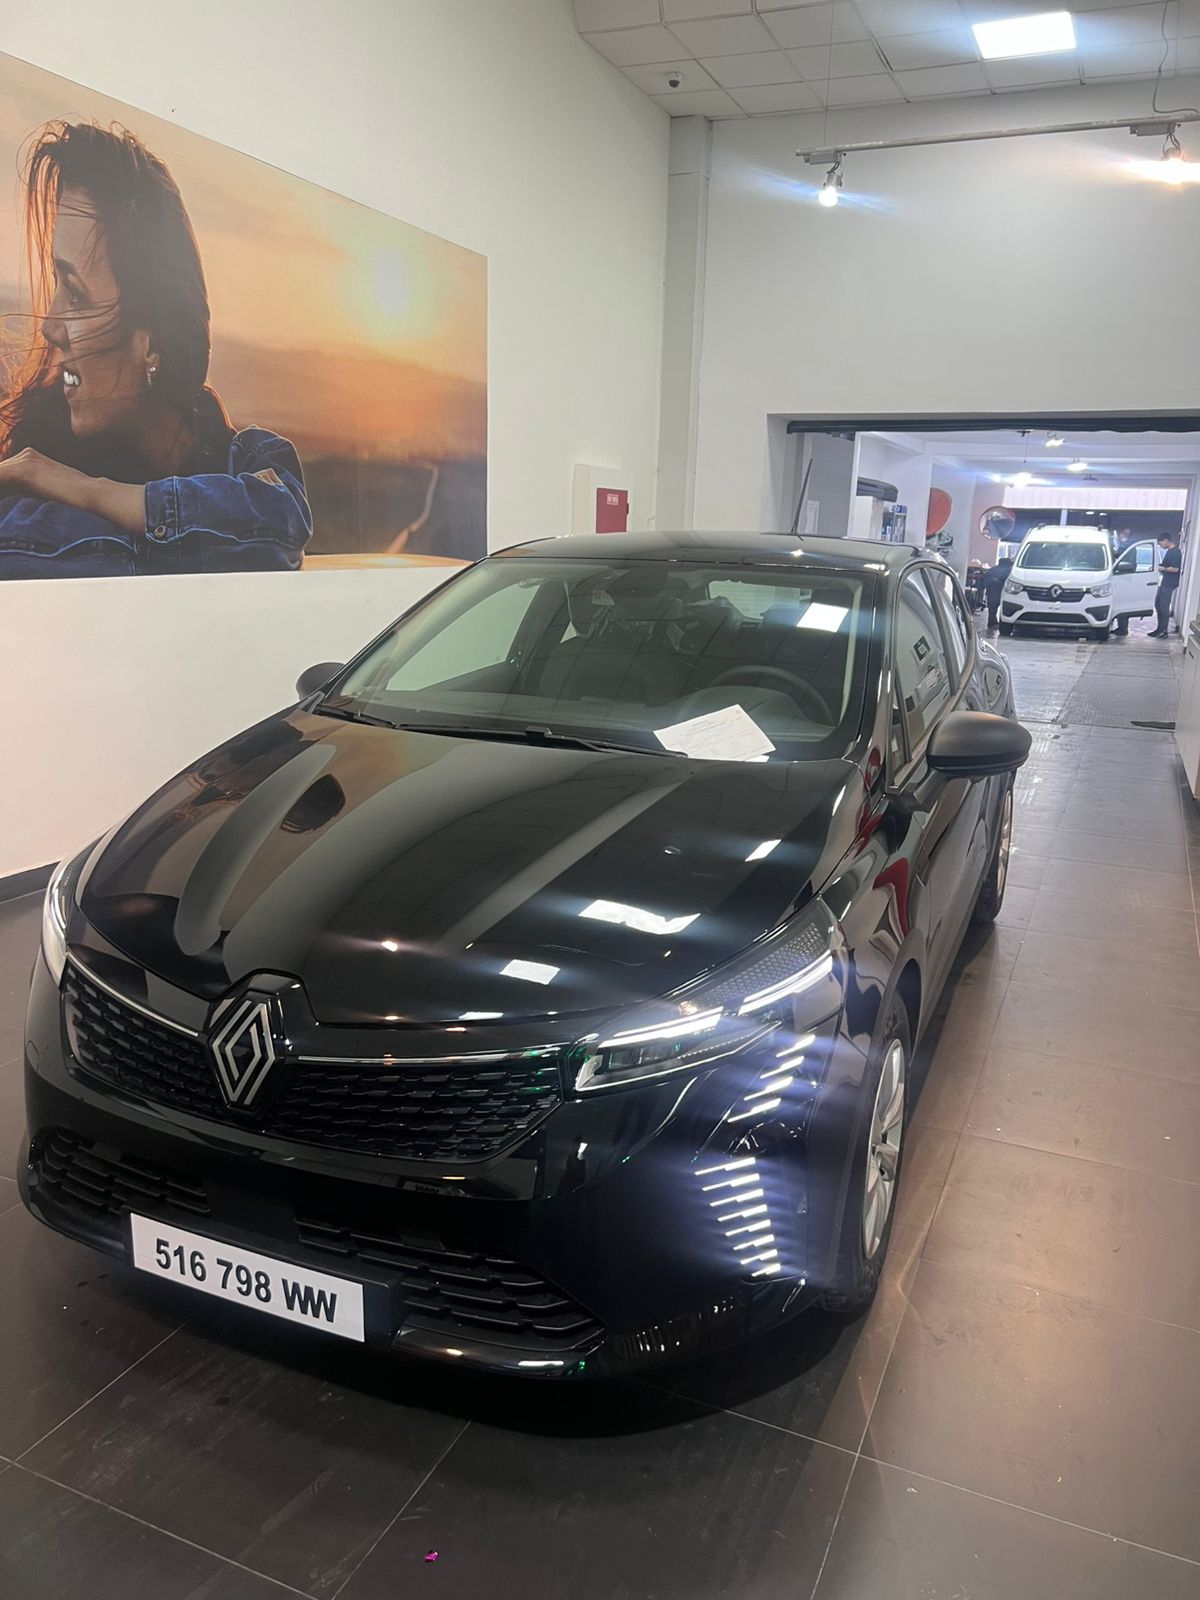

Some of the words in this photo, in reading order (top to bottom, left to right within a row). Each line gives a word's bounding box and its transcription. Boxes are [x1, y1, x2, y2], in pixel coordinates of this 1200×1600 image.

[155, 1238, 207, 1282] 516
[216, 1258, 272, 1303] 798
[281, 1278, 338, 1323] WW
